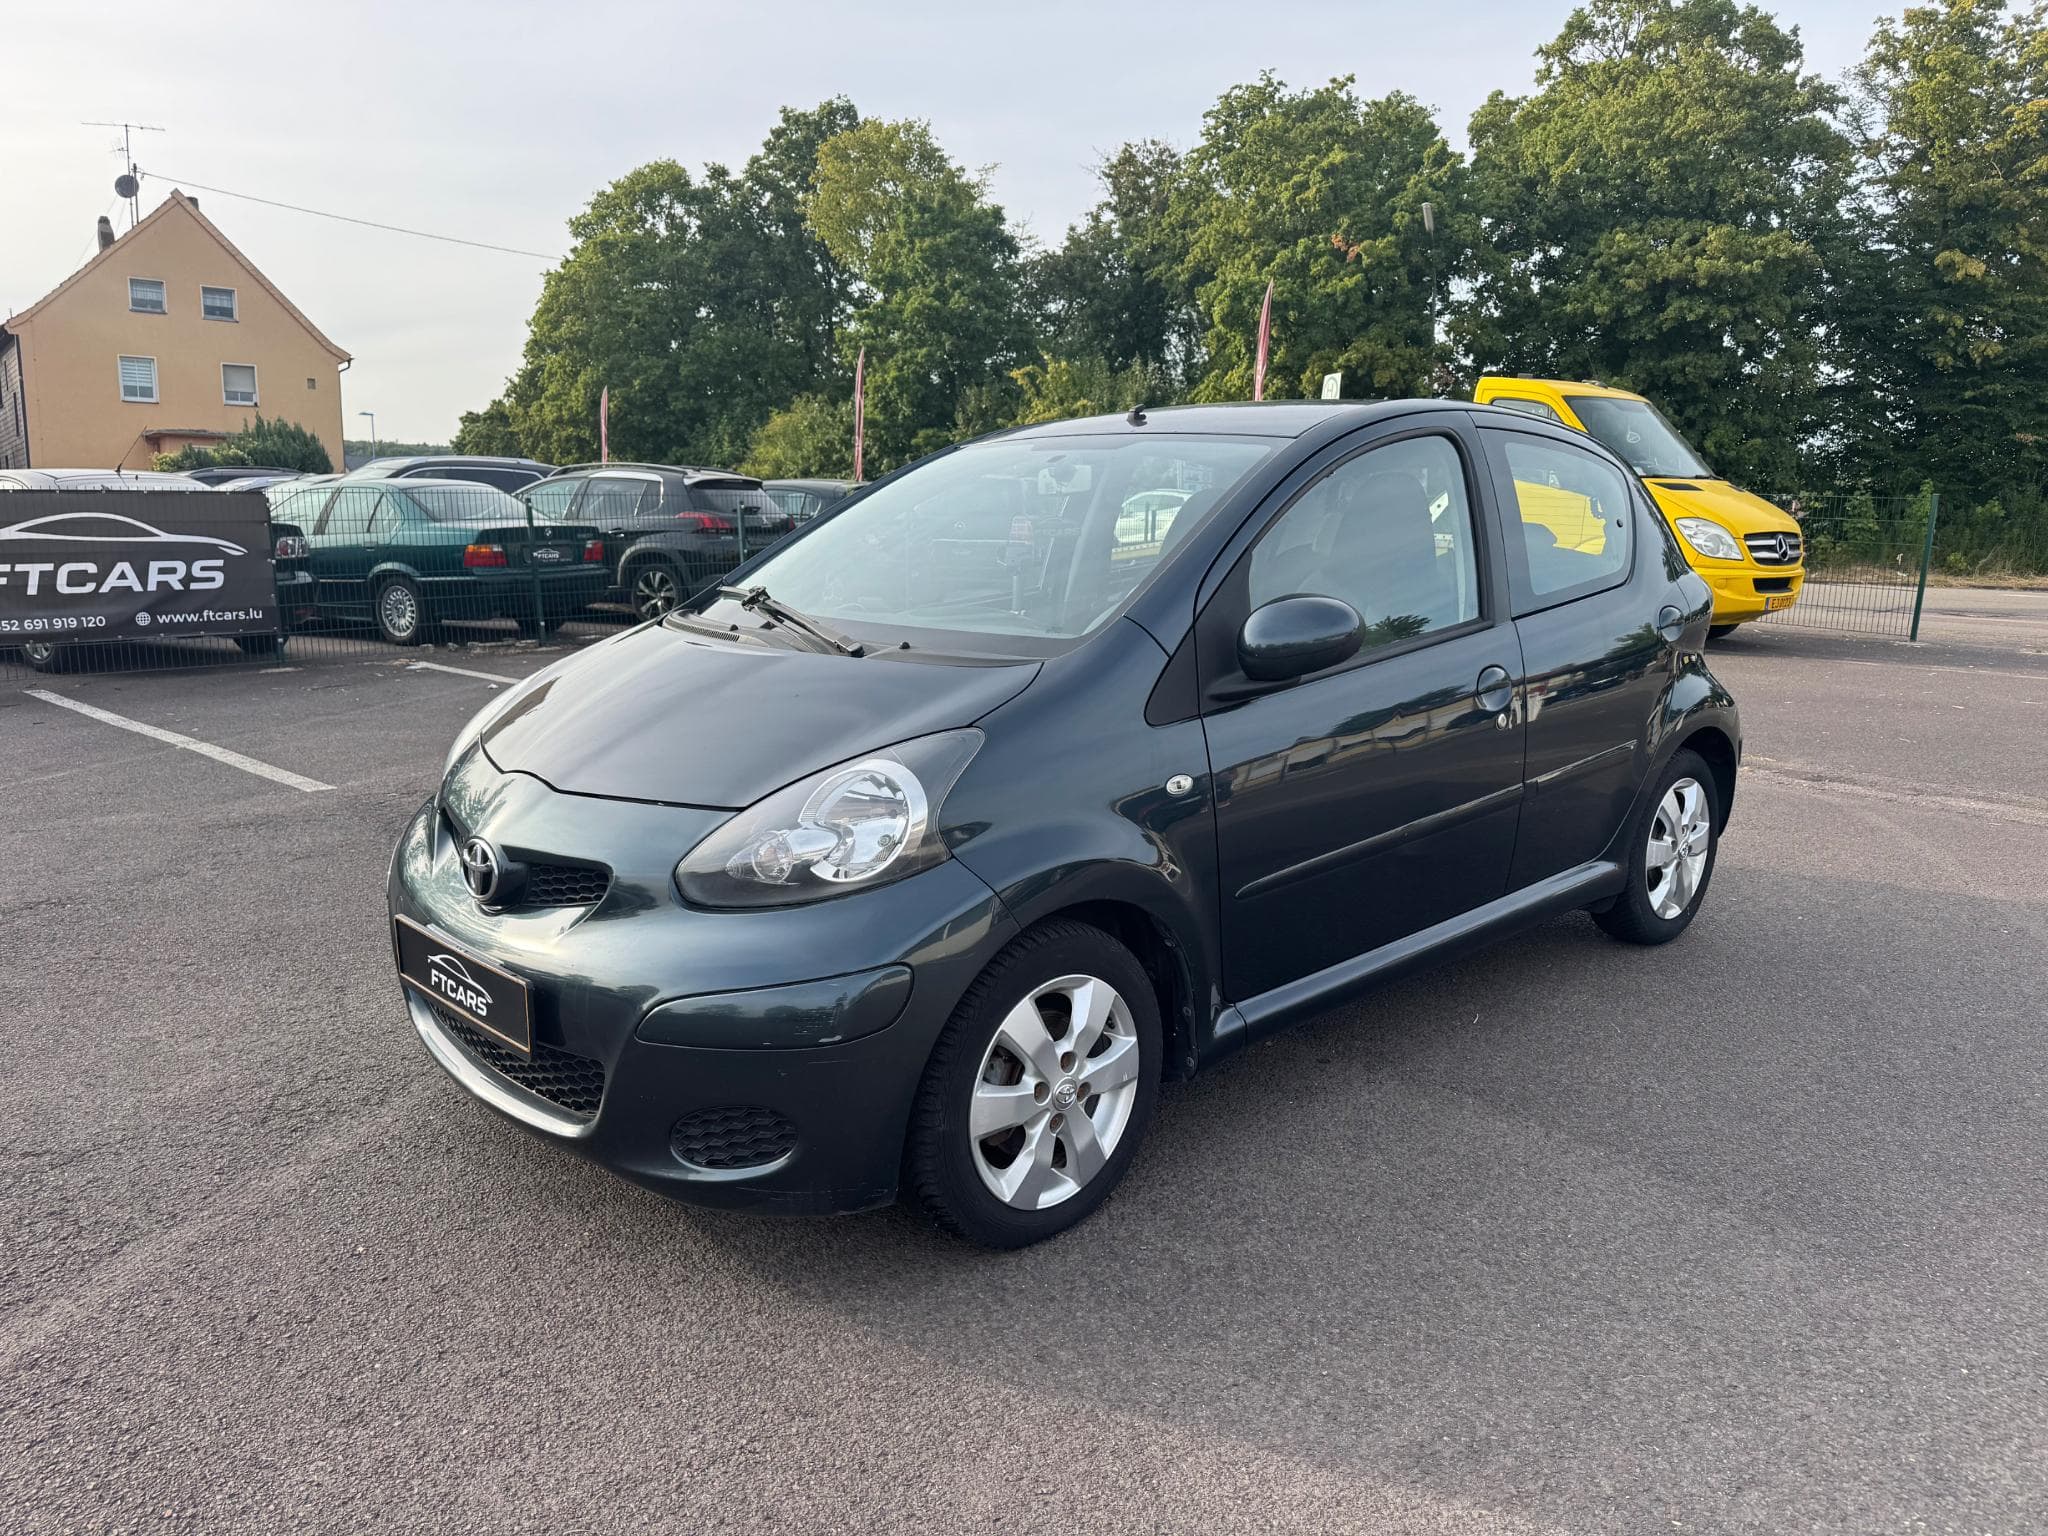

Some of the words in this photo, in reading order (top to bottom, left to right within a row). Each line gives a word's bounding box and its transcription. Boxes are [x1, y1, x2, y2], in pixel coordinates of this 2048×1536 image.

[0, 619, 20, 631] 52
[23, 618, 49, 630] 691
[52, 617, 78, 629] 919
[80, 615, 106, 628] 120
[156, 607, 263, 624] www.ftcars.lu
[431, 968, 487, 1017] FTCARS
